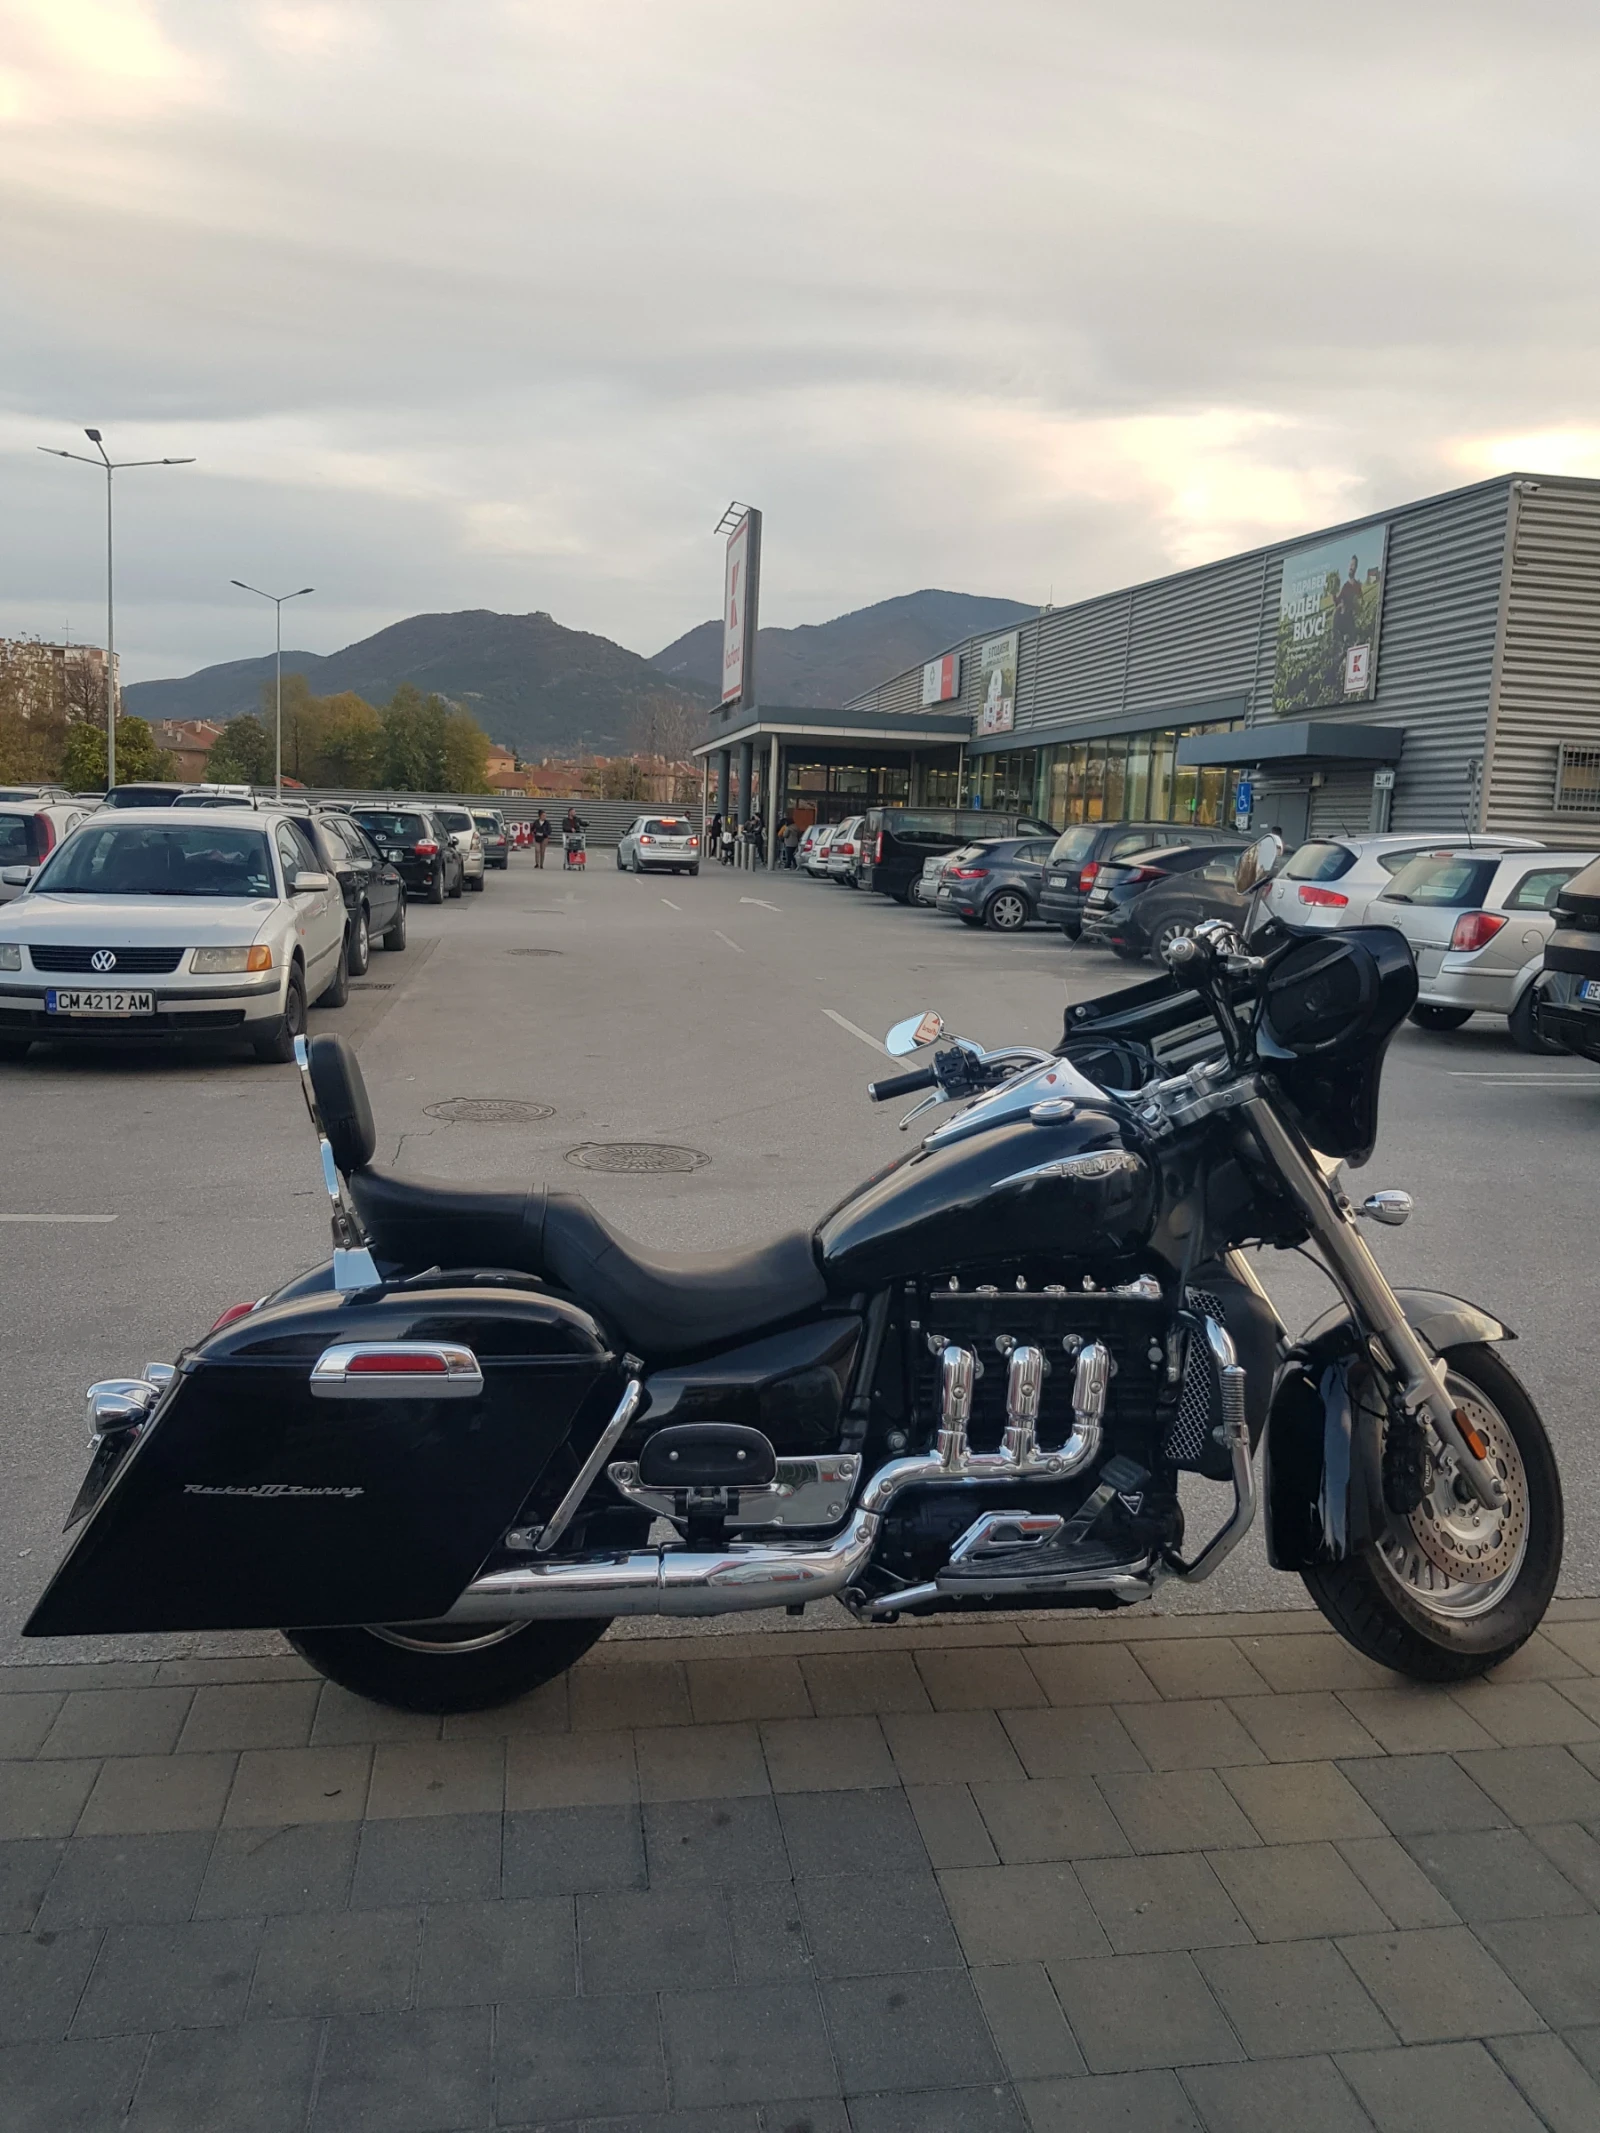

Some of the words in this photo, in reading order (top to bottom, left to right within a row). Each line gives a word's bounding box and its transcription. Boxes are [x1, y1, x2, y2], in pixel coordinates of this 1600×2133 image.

[730, 559, 740, 630] K
[1280, 594, 1320, 621] РОДЕН
[1293, 612, 1326, 641] ВКУС!
[1353, 655, 1362, 673] K
[58, 993, 80, 1010] CM
[83, 994, 125, 1011] 4212
[128, 994, 150, 1011] AM
[1055, 1156, 1128, 1179] TRIUMPH
